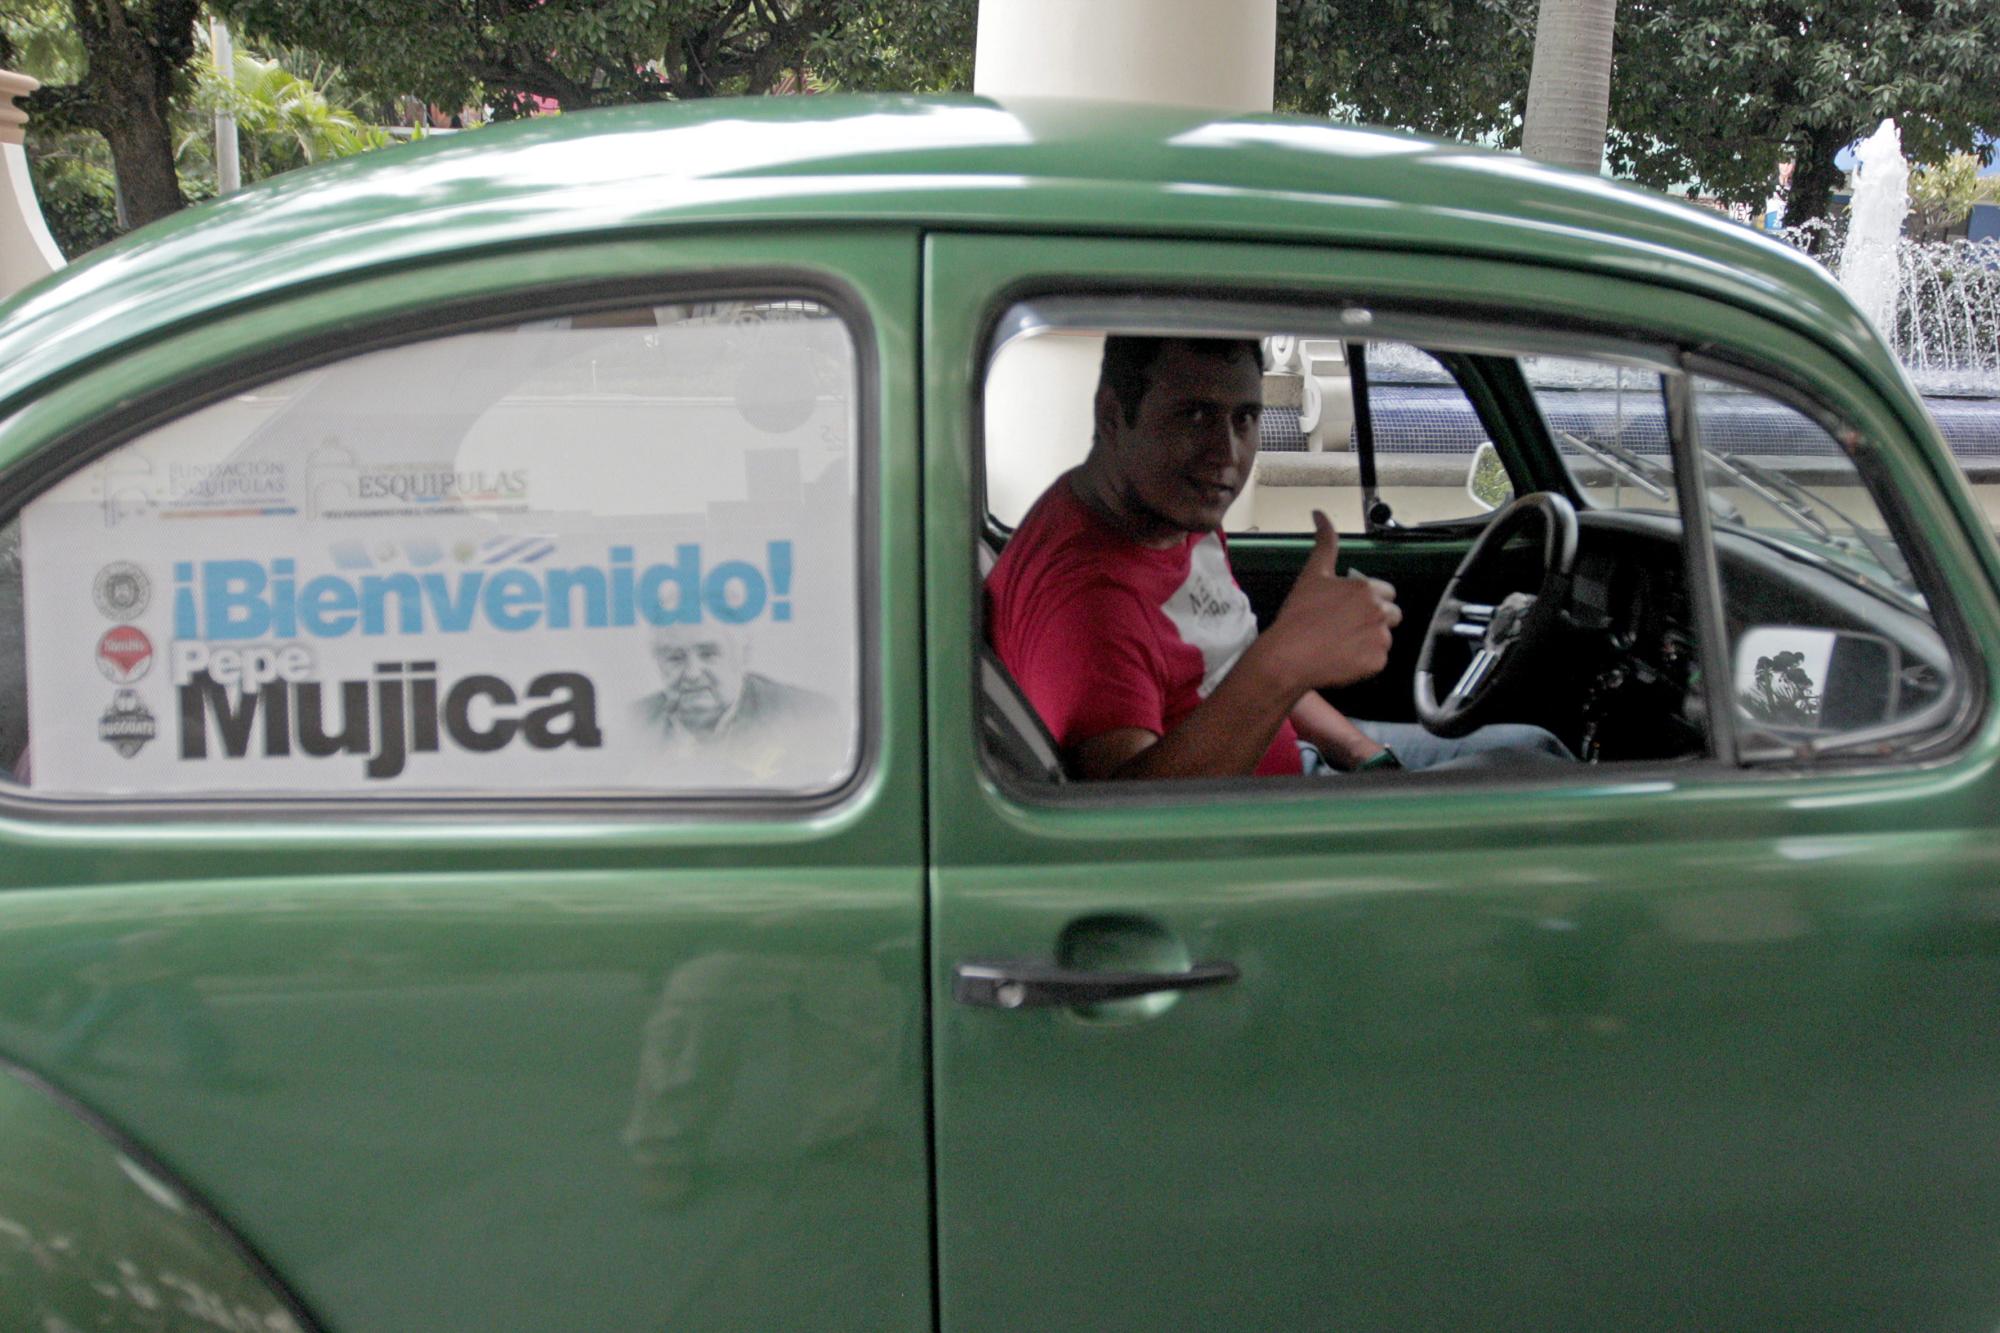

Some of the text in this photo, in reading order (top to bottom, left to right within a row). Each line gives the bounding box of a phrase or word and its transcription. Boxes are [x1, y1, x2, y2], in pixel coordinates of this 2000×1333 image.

[358, 470, 529, 501] ESQUIPULAS
[173, 540, 794, 641] ¡Bienvenido!
[173, 640, 312, 694] Pepe
[178, 660, 603, 779] Mujica
